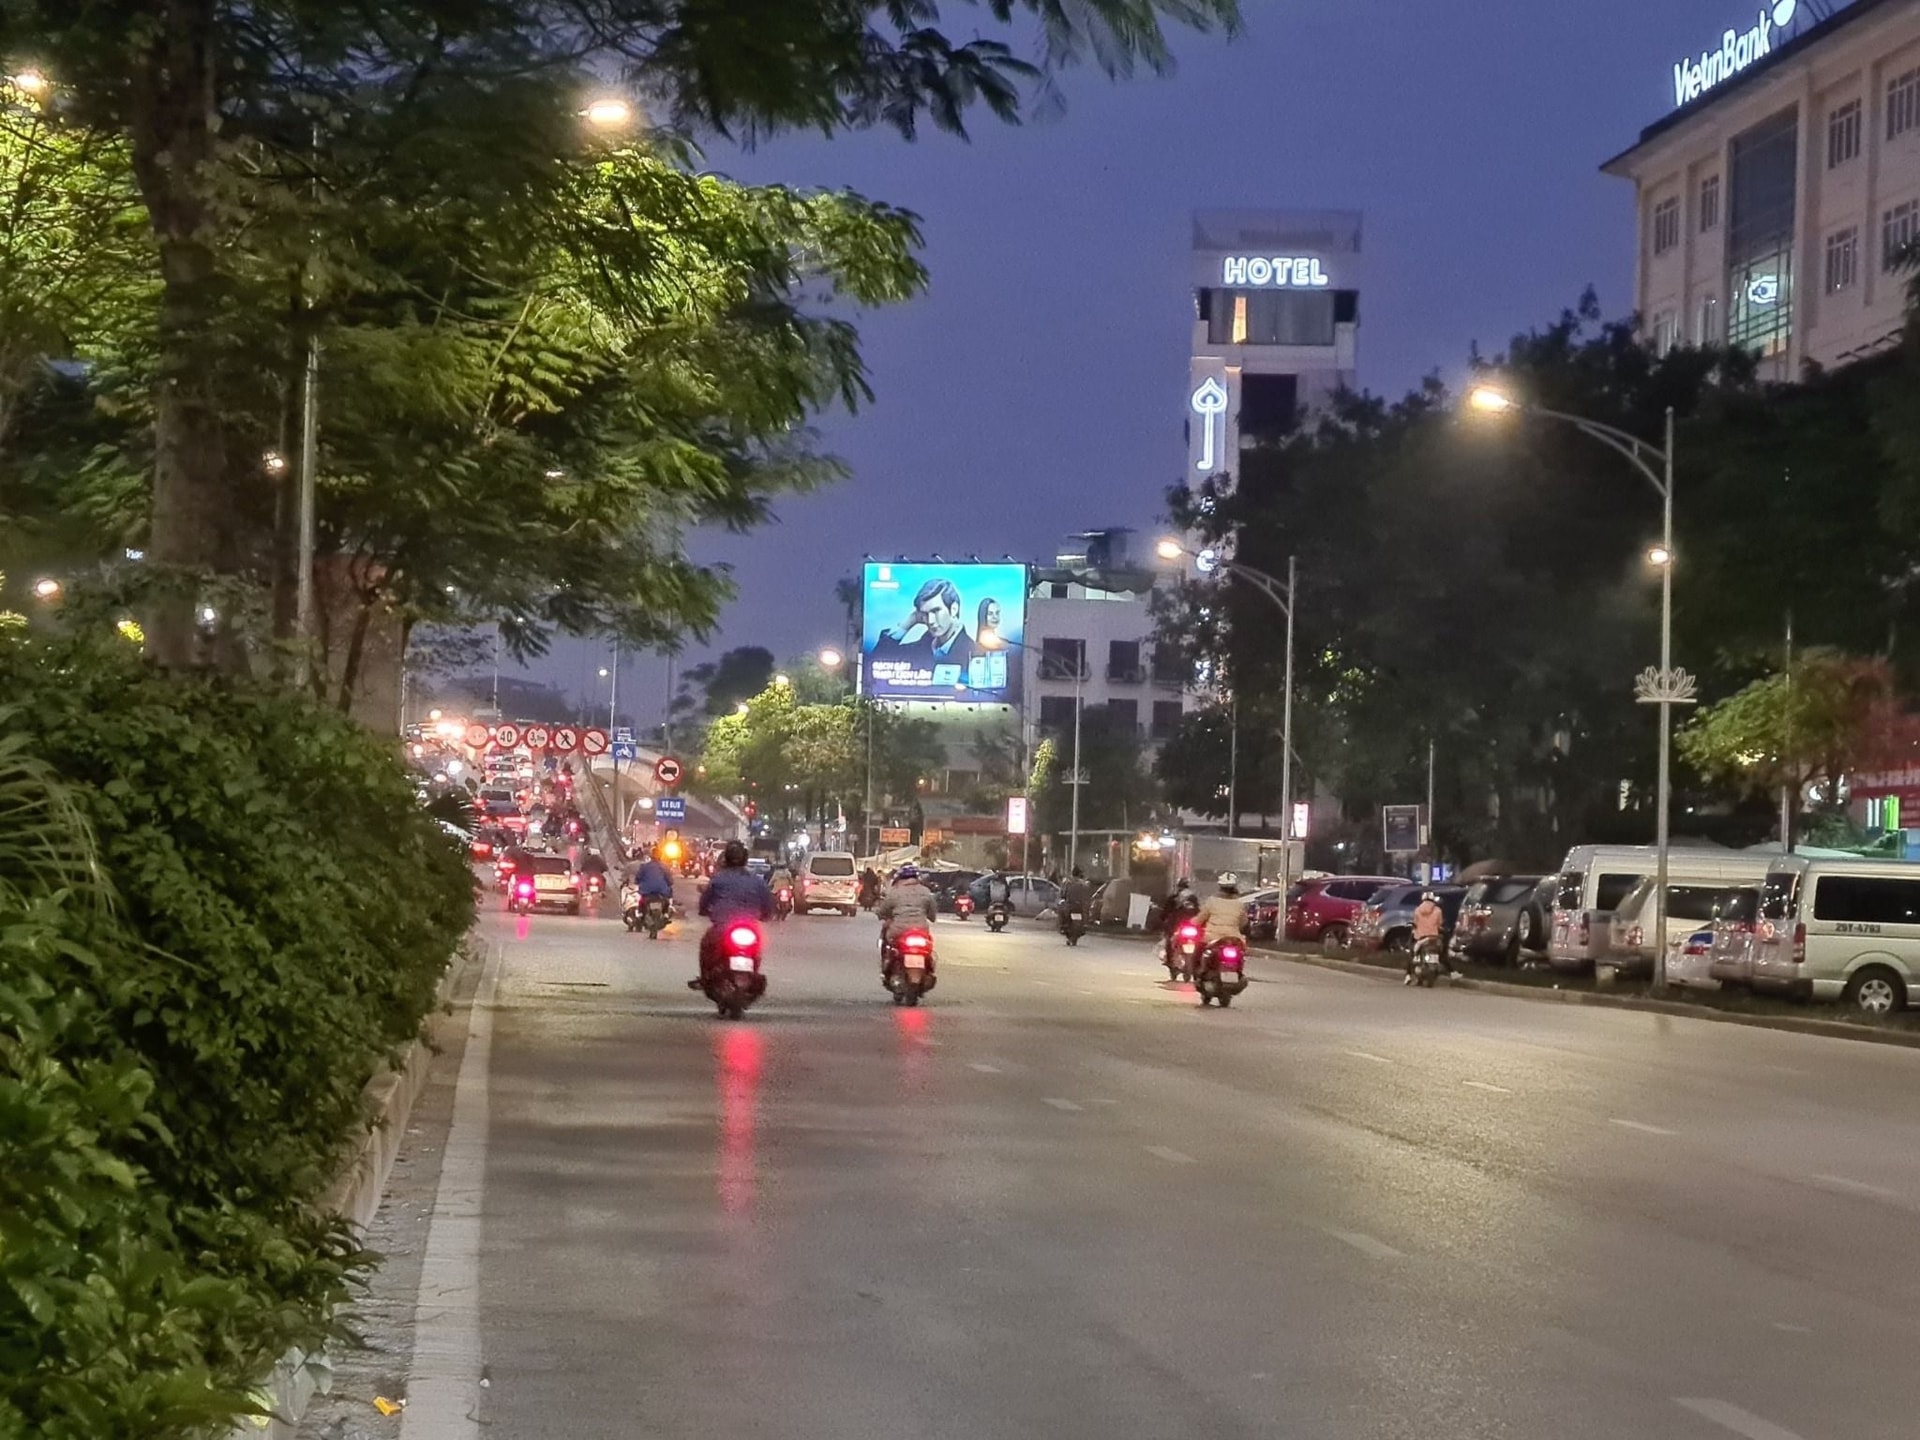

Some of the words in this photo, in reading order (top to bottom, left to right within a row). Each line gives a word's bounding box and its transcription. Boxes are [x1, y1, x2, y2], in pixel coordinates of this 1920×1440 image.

[1674, 9, 1772, 107] VietinBank
[1224, 257, 1328, 285] HOTEL
[500, 730, 513, 743] 40
